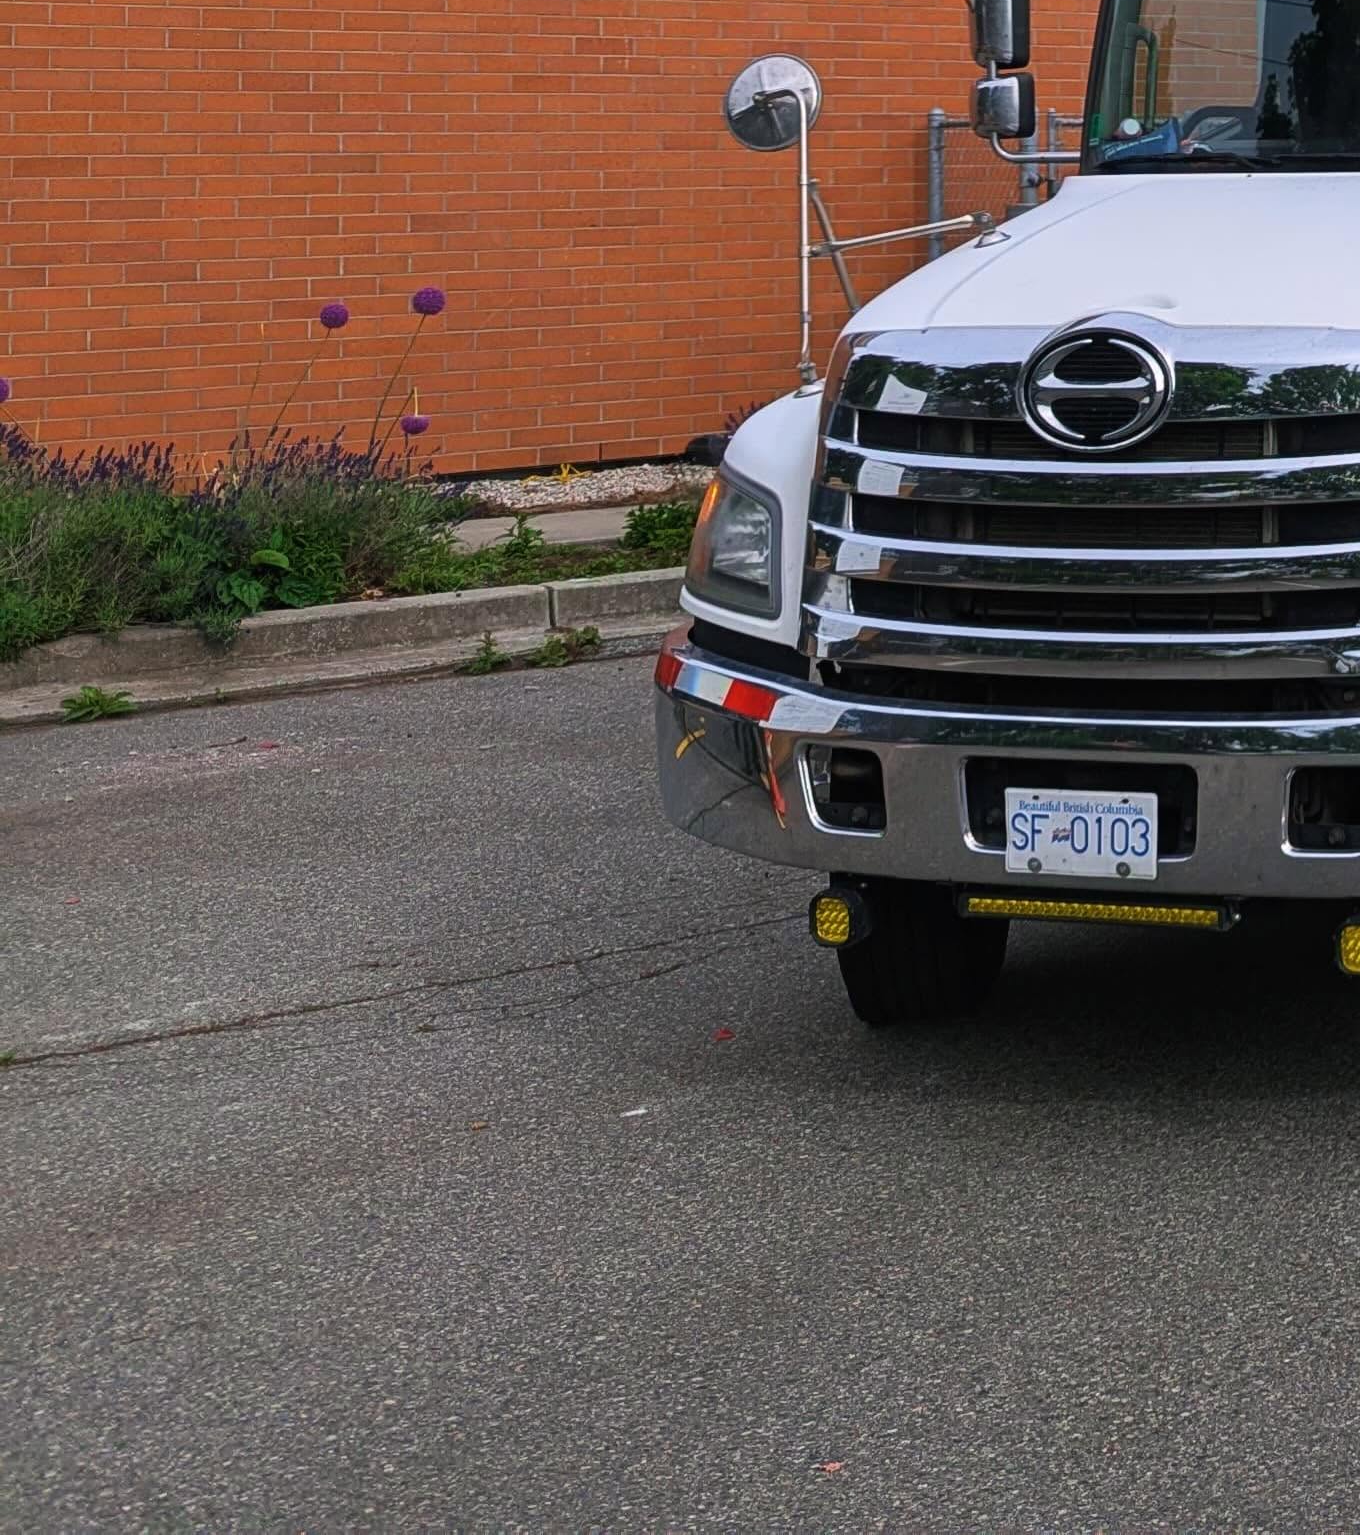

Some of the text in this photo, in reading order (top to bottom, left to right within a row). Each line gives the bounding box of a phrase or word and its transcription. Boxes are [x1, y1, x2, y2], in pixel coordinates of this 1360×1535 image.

[1019, 800, 1143, 816] Beautiful British Columbia
[1011, 813, 1150, 856] SF 0103
